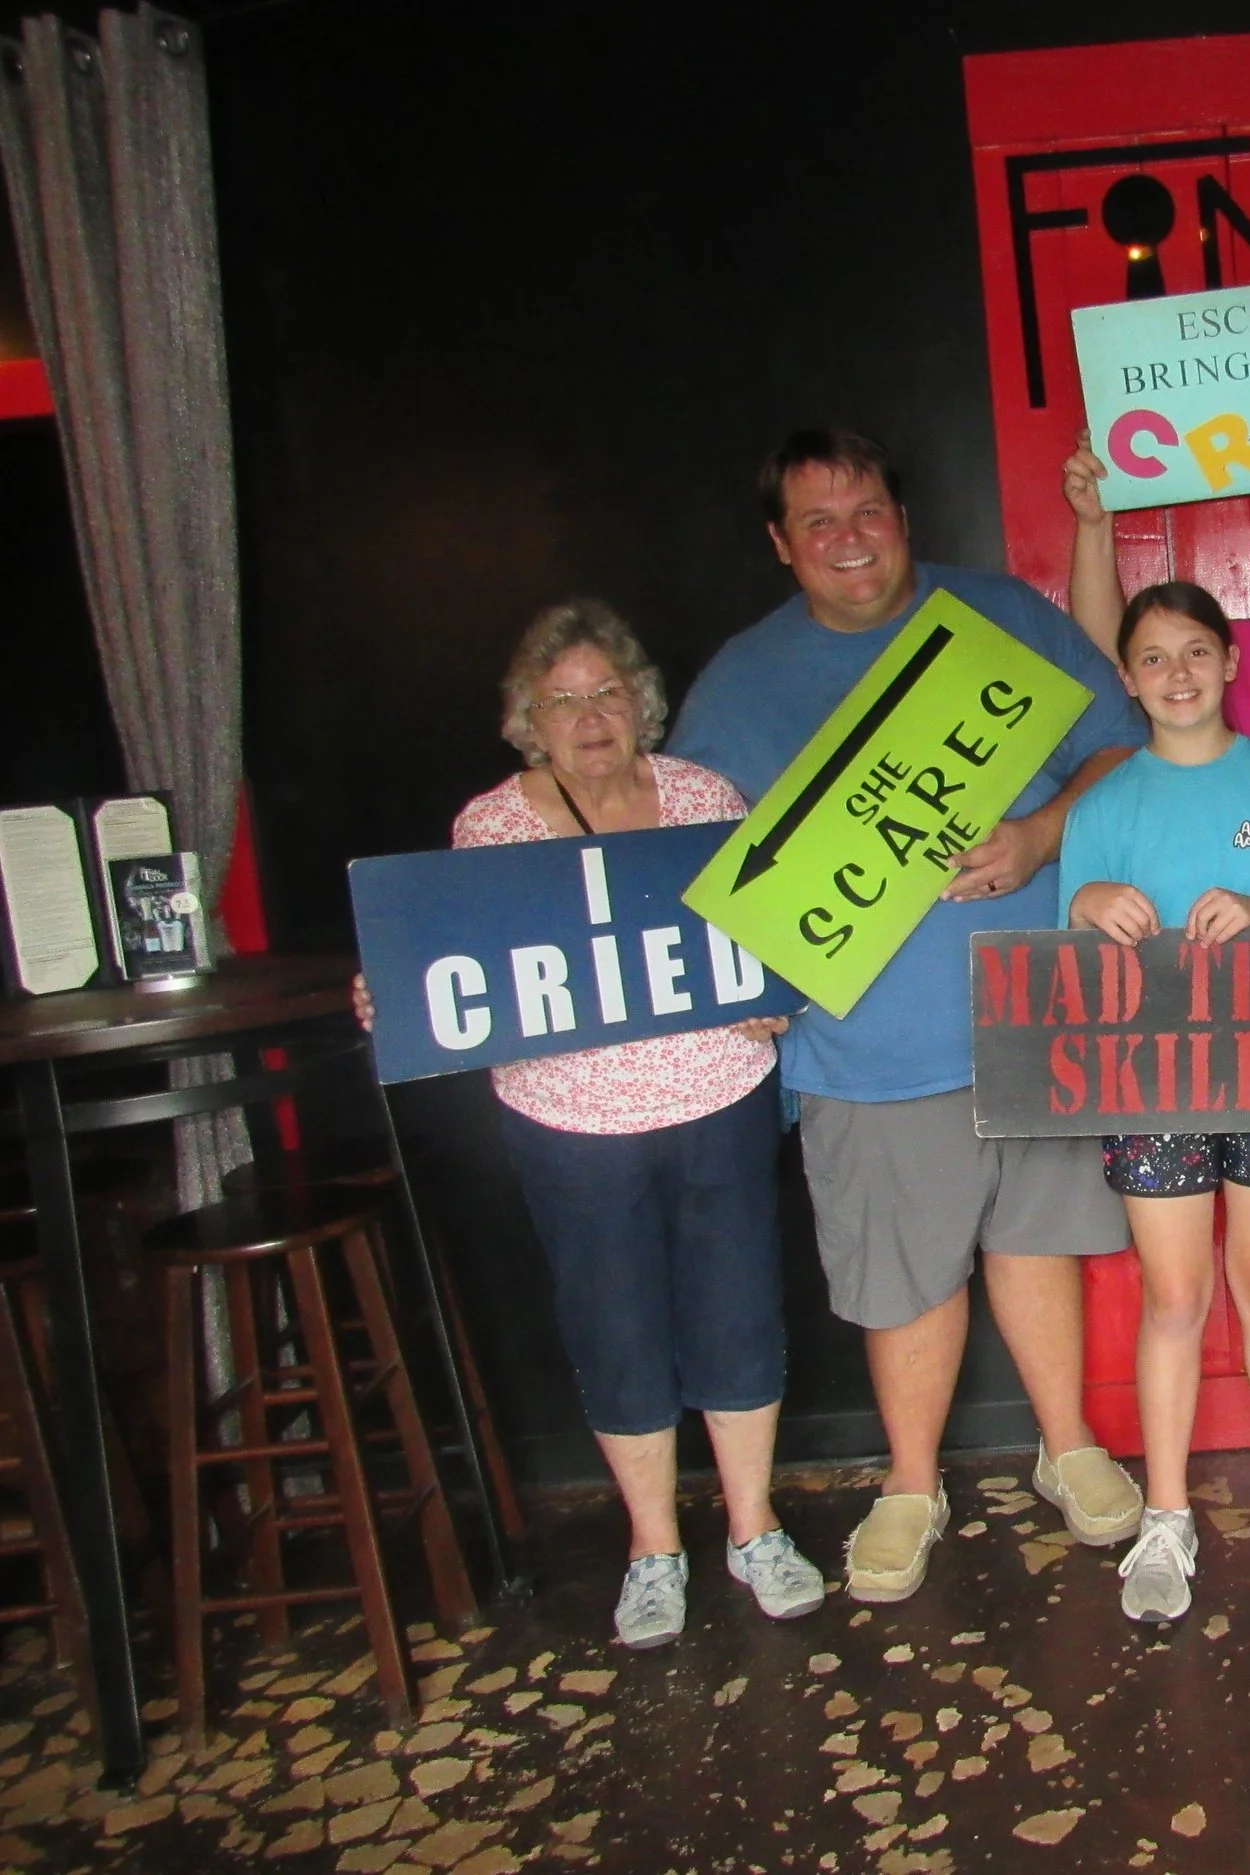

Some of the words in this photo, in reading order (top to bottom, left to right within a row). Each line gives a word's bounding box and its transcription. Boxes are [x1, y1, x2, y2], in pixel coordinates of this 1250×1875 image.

[799, 680, 1033, 959] SCARES
[845, 751, 912, 825] SHE
[922, 812, 981, 873] ME
[580, 847, 613, 924] I
[424, 921, 765, 1050] CRIED
[977, 942, 1144, 1027] MAD
